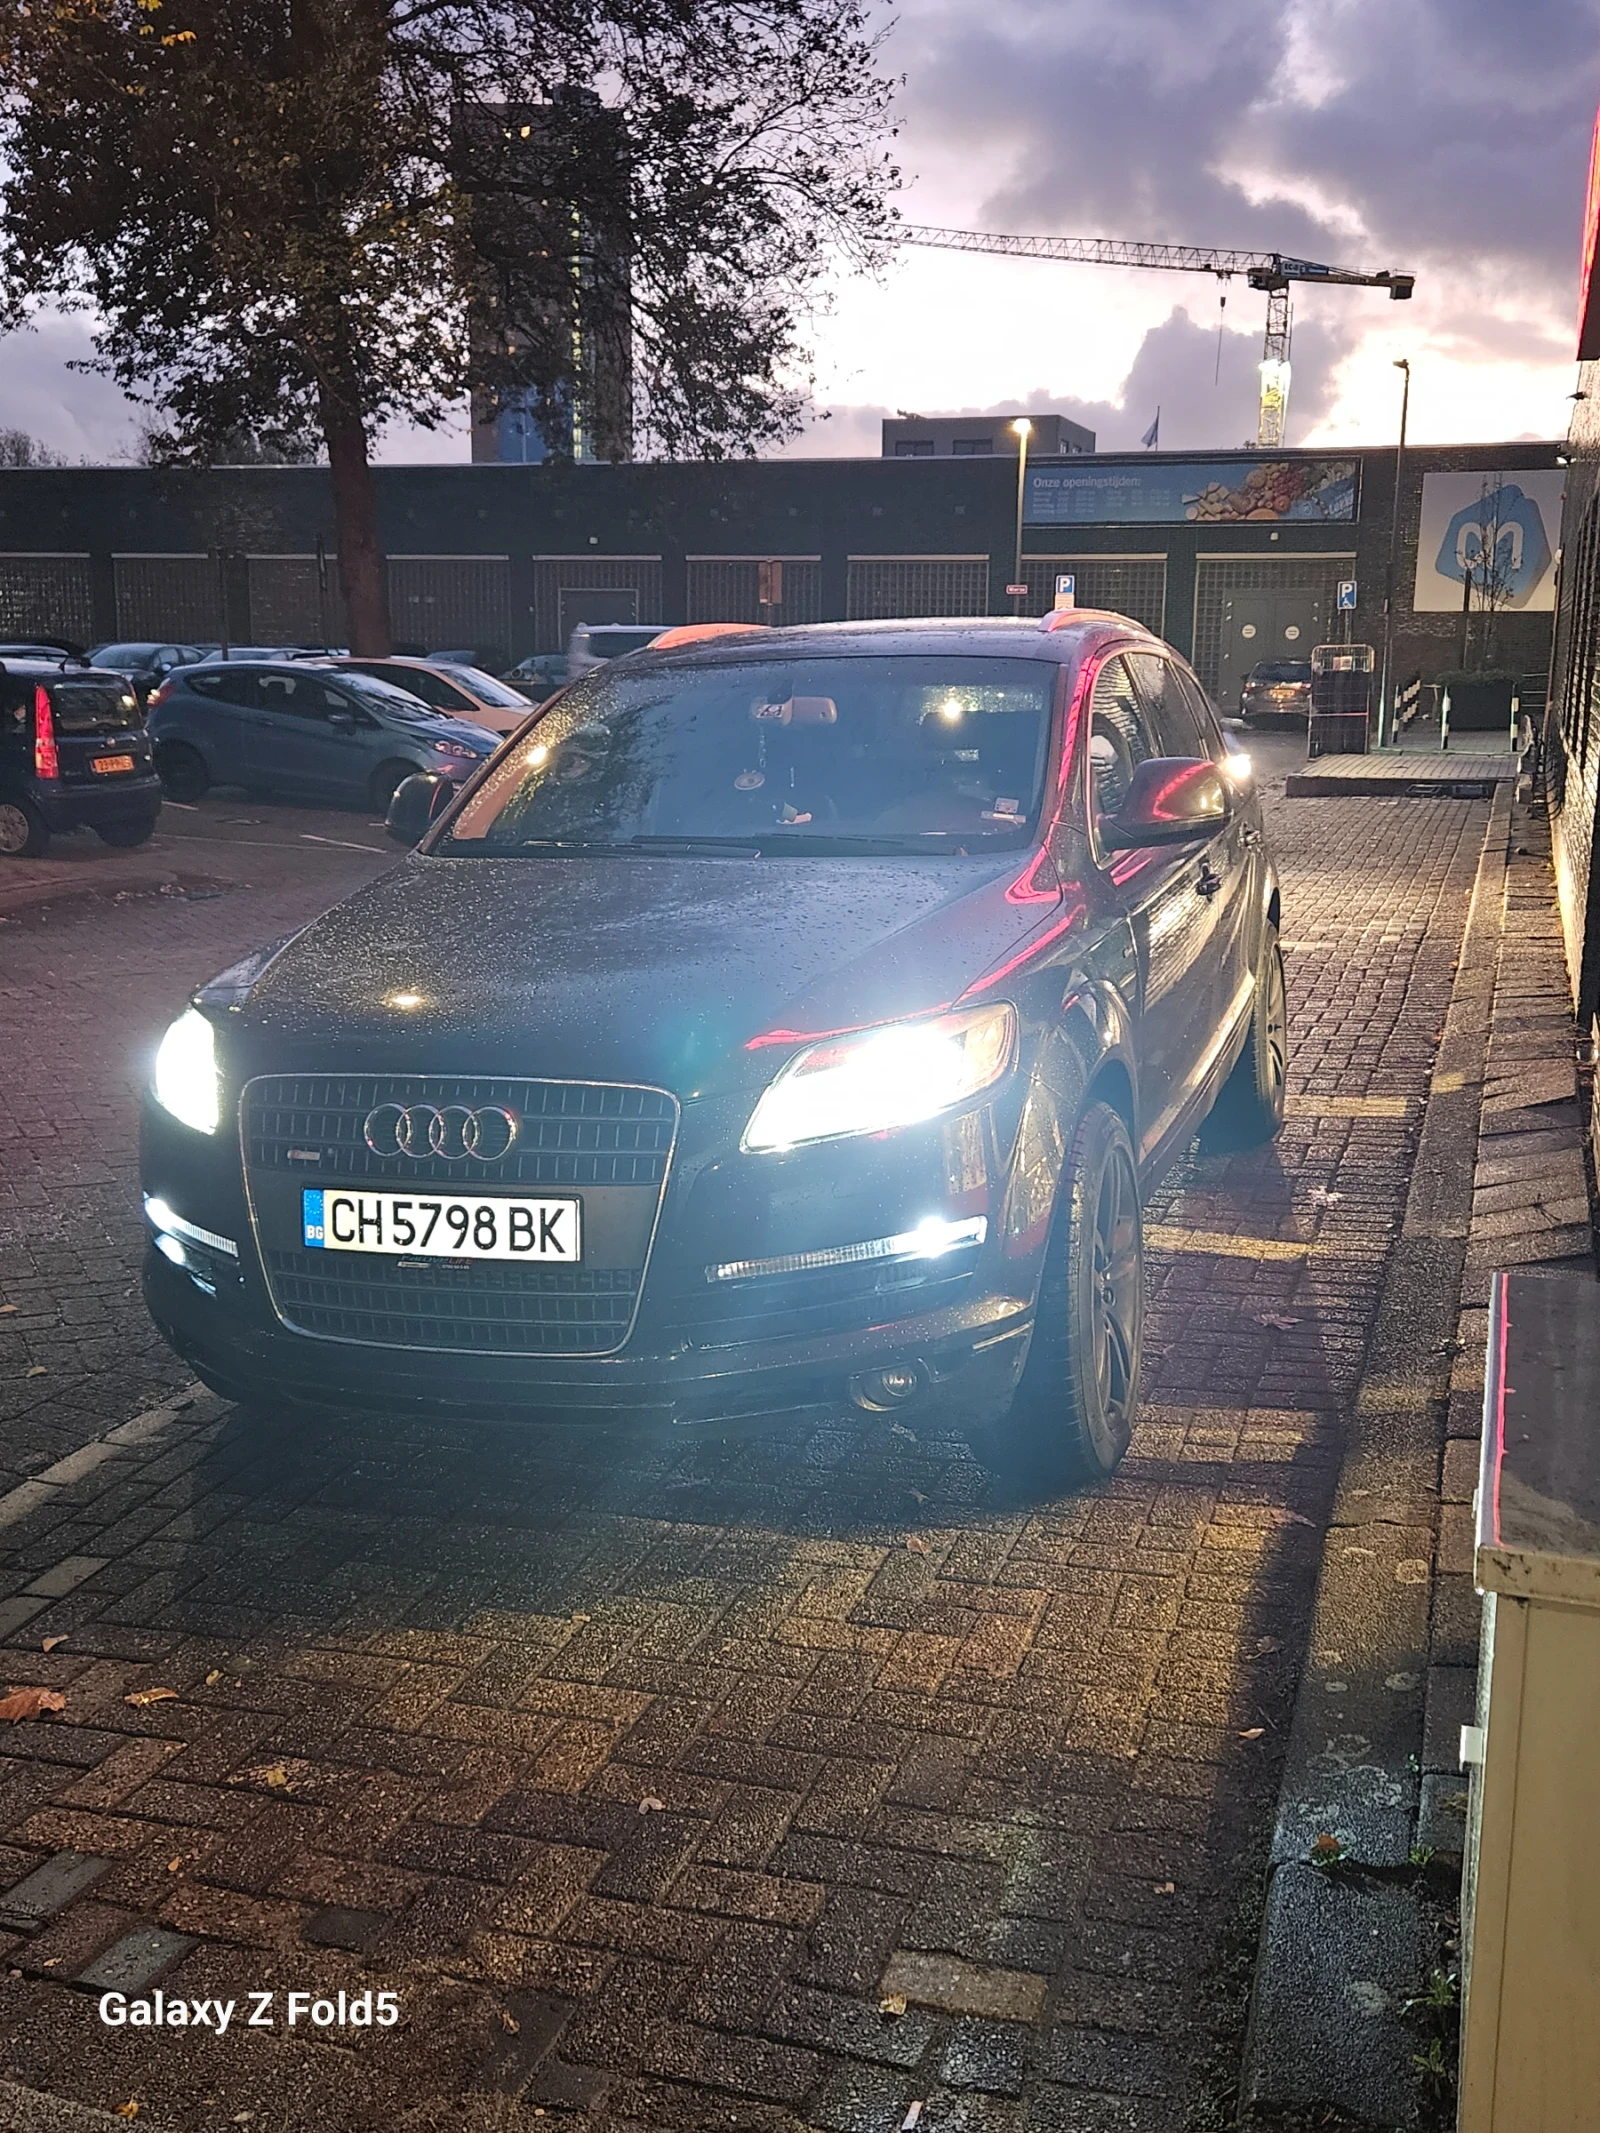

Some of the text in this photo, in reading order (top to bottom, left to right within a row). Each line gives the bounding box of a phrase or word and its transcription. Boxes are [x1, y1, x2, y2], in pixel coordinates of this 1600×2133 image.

[1033, 477, 1060, 488] Onze
[1060, 577, 1071, 592] P
[1342, 583, 1353, 598] P
[306, 1225, 324, 1239] BG
[332, 1198, 566, 1254] CH 5798 BK
